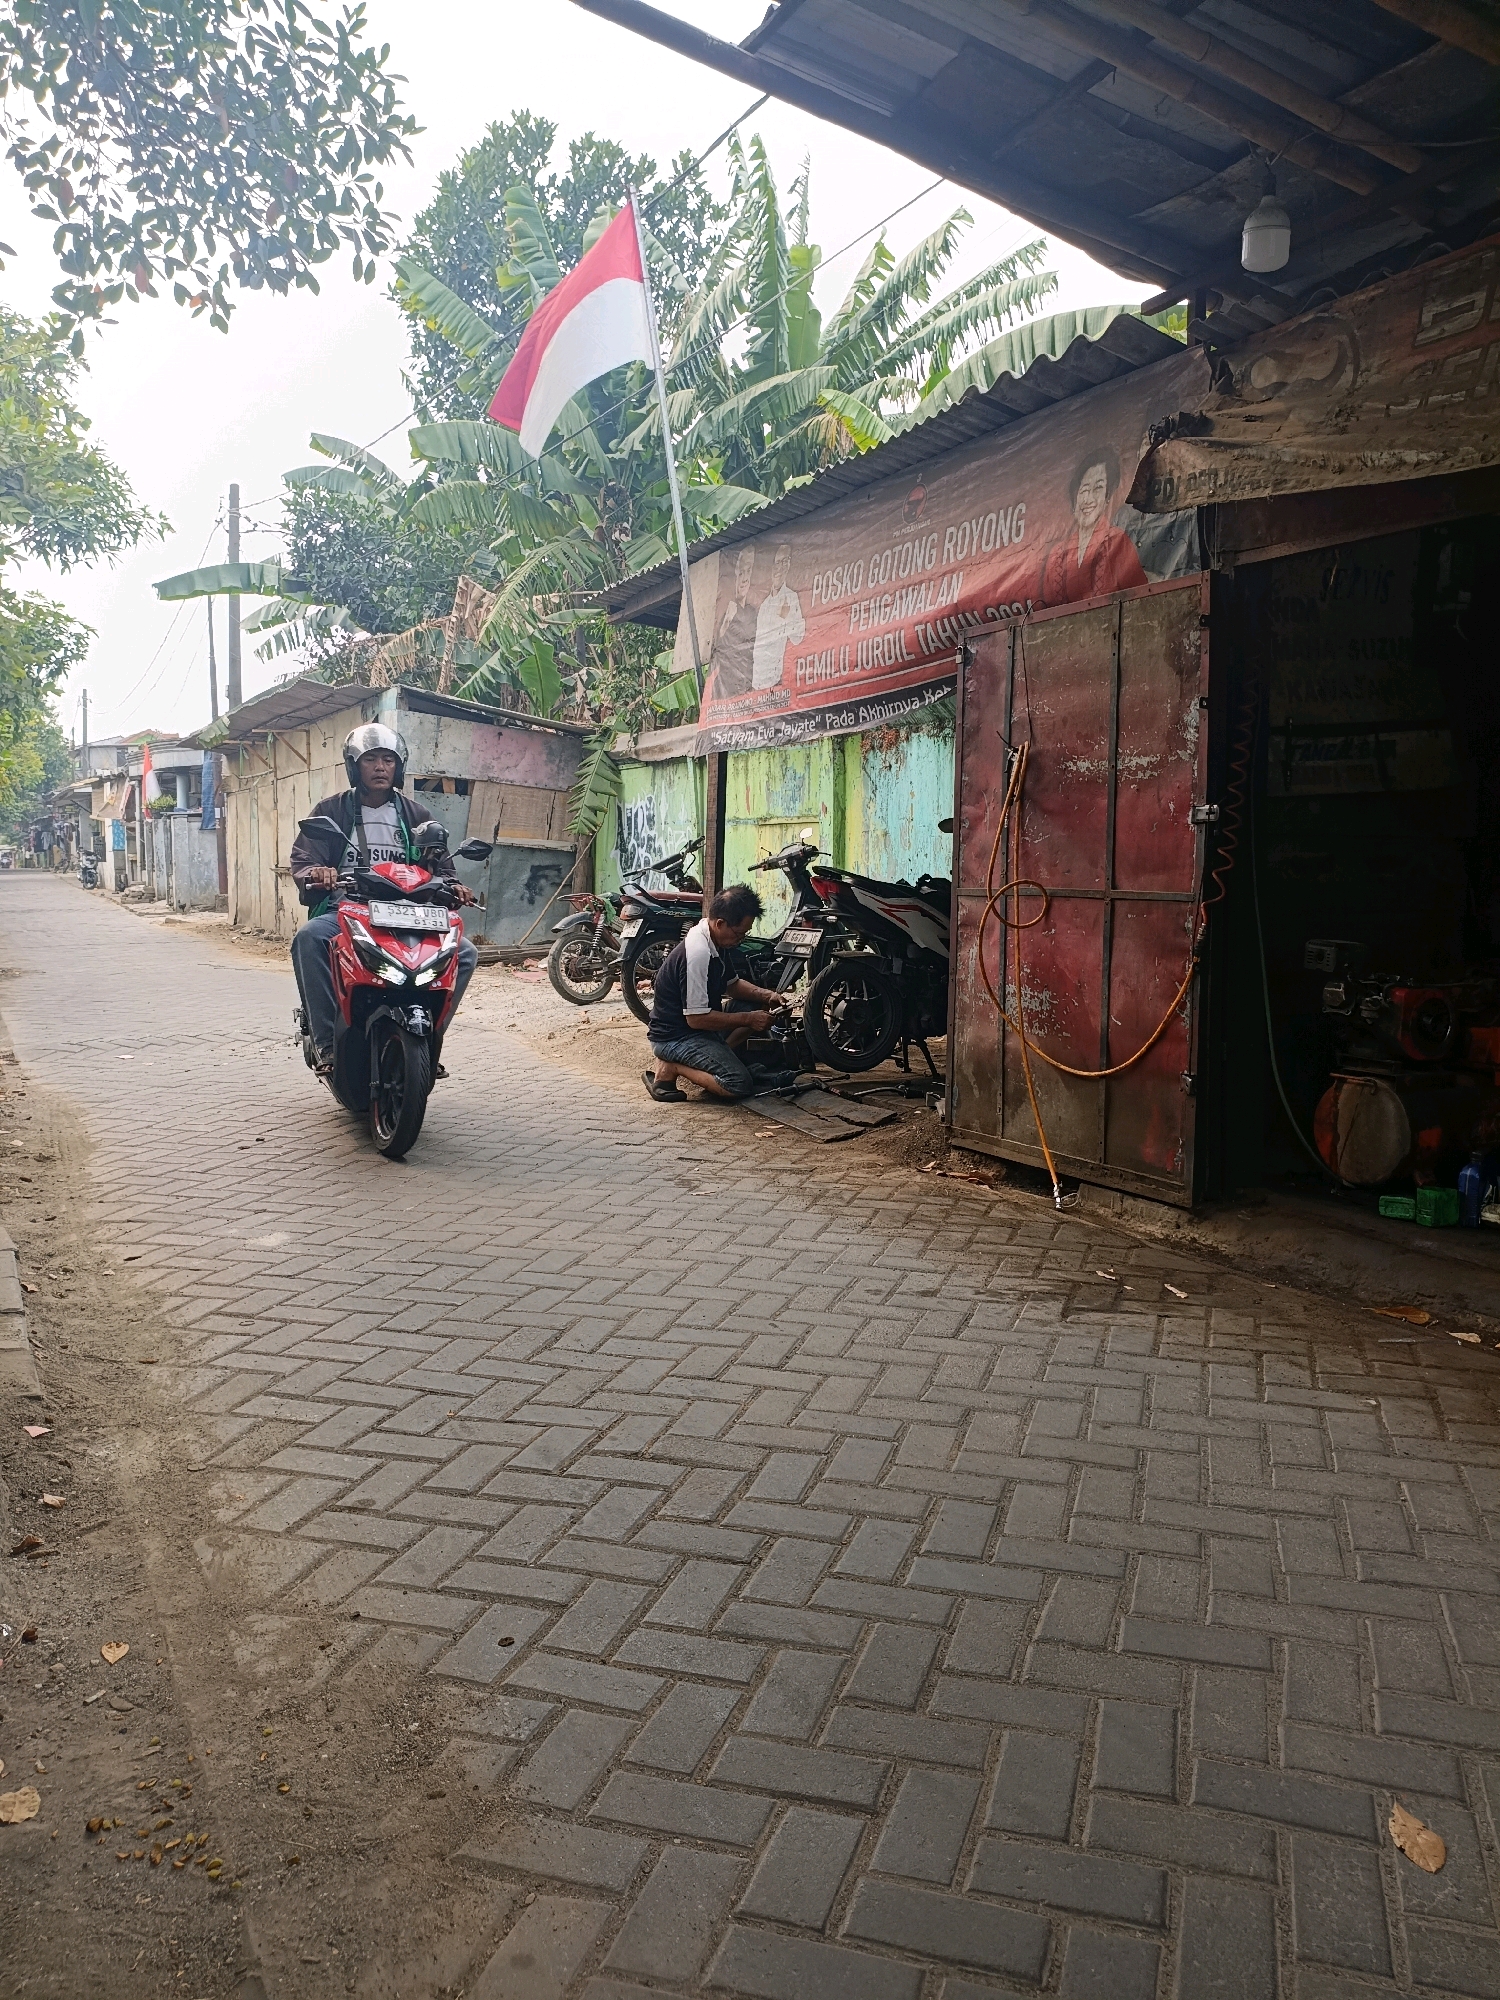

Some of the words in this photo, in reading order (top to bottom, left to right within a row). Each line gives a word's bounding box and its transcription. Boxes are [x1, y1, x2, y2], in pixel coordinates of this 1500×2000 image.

[811, 560, 865, 607] POSKO
[867, 532, 938, 589] GOTONG
[942, 502, 1027, 565] ROYONG
[848, 571, 964, 634] PENGAWALAN
[796, 645, 850, 687] PEMILU
[853, 629, 916, 674] JURDIL
[711, 730, 755, 746] "Satyam
[757, 725, 775, 740] Eva
[778, 714, 821, 739] Jayate"
[826, 710, 855, 729] Pada
[859, 696, 920, 723] Akhirnya
[373, 904, 380, 914] A
[387, 905, 417, 916] 5323
